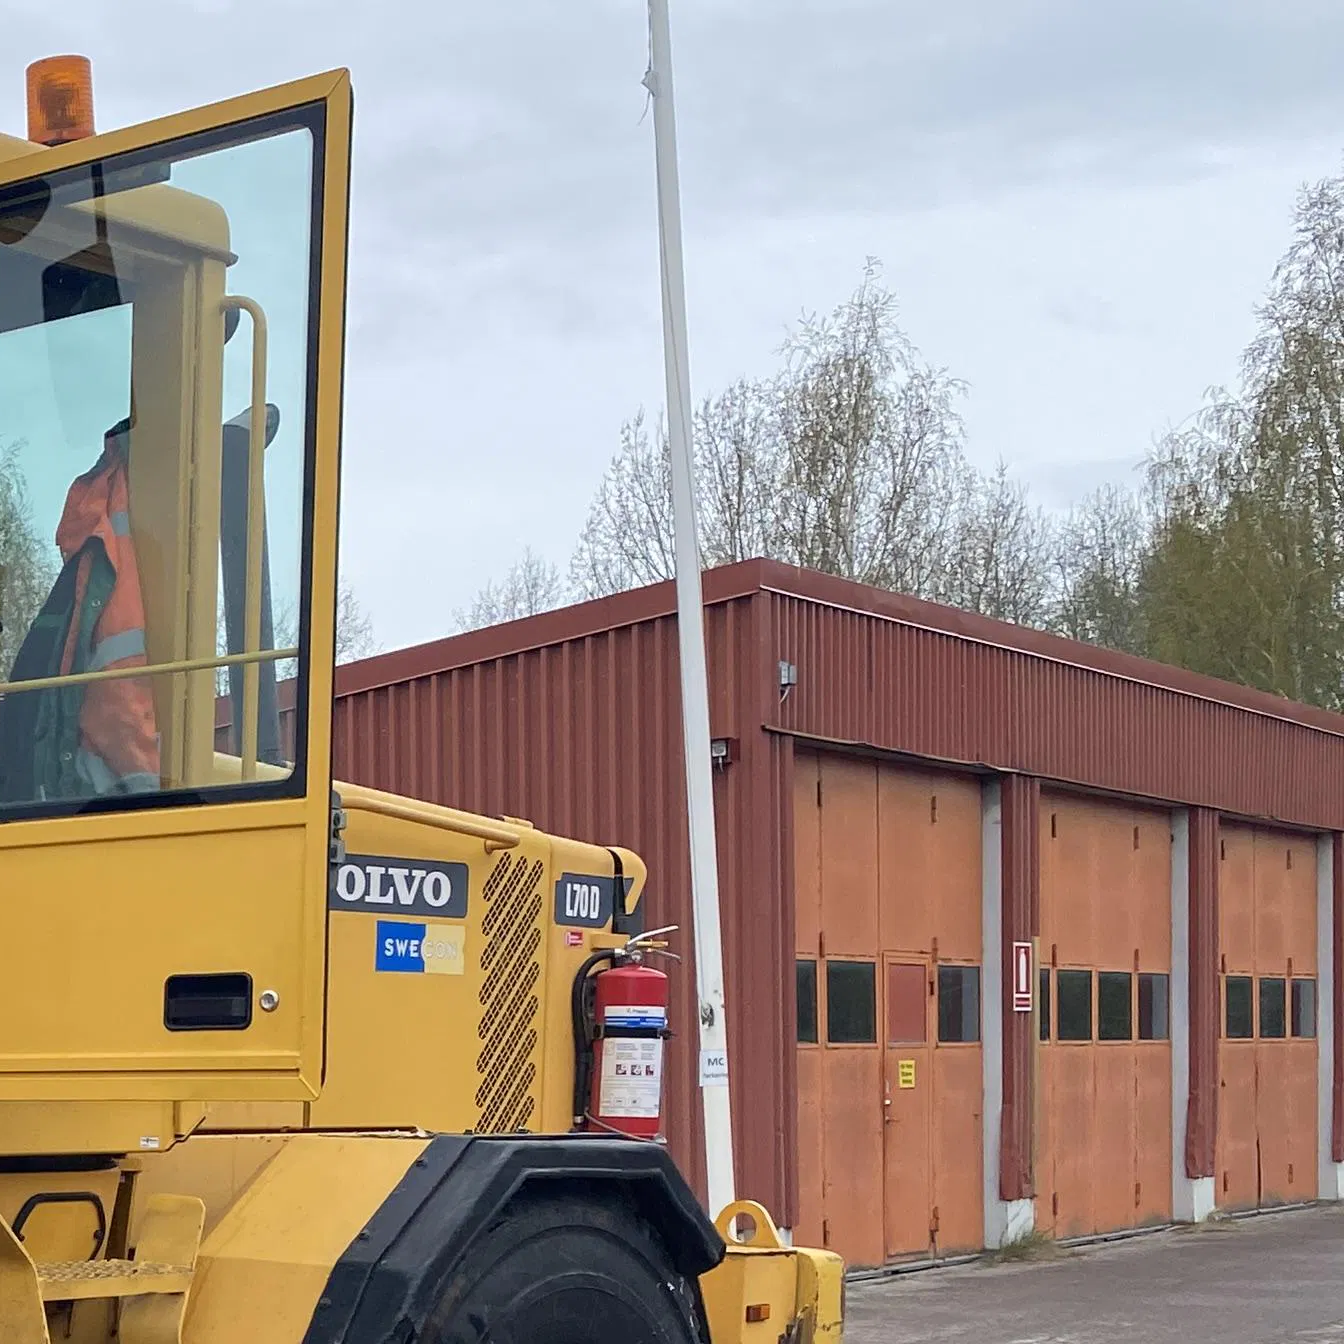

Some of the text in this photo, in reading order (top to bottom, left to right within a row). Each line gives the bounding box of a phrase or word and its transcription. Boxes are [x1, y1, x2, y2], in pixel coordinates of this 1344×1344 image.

[336, 863, 452, 908] OLVO
[565, 882, 600, 919] L70D
[384, 937, 458, 959] SWECON
[707, 1057, 724, 1066] MC
